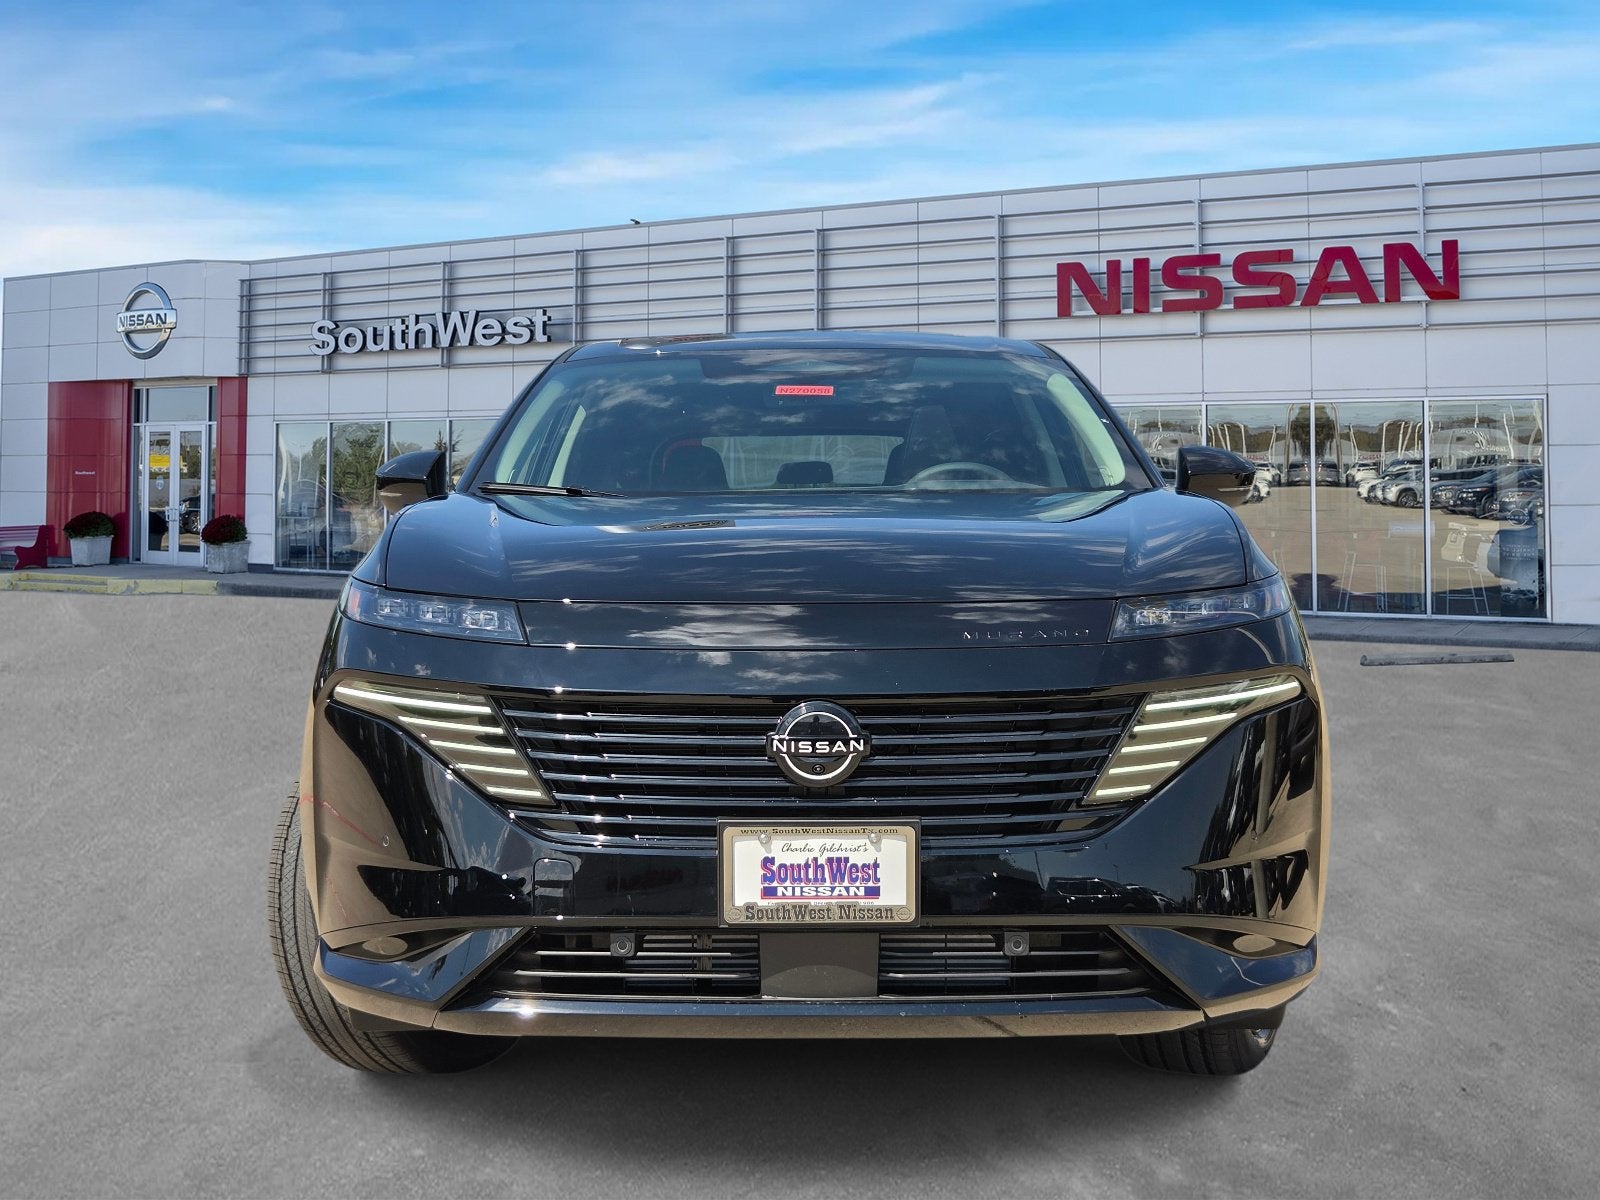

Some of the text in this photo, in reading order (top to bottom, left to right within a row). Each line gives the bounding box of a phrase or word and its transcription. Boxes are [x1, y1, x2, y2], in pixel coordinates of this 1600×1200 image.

[1056, 239, 1461, 318] NISSAN
[119, 312, 168, 328] NISSAN
[308, 308, 552, 356] SouthWest
[772, 738, 865, 754] NISSAN
[740, 827, 899, 835] wwwSouthWestNissanTx.com
[781, 842, 816, 853] Charlie
[760, 855, 881, 886] SouthWest
[776, 886, 866, 897] NISSAN
[744, 904, 895, 921] SouthWest Nissan
